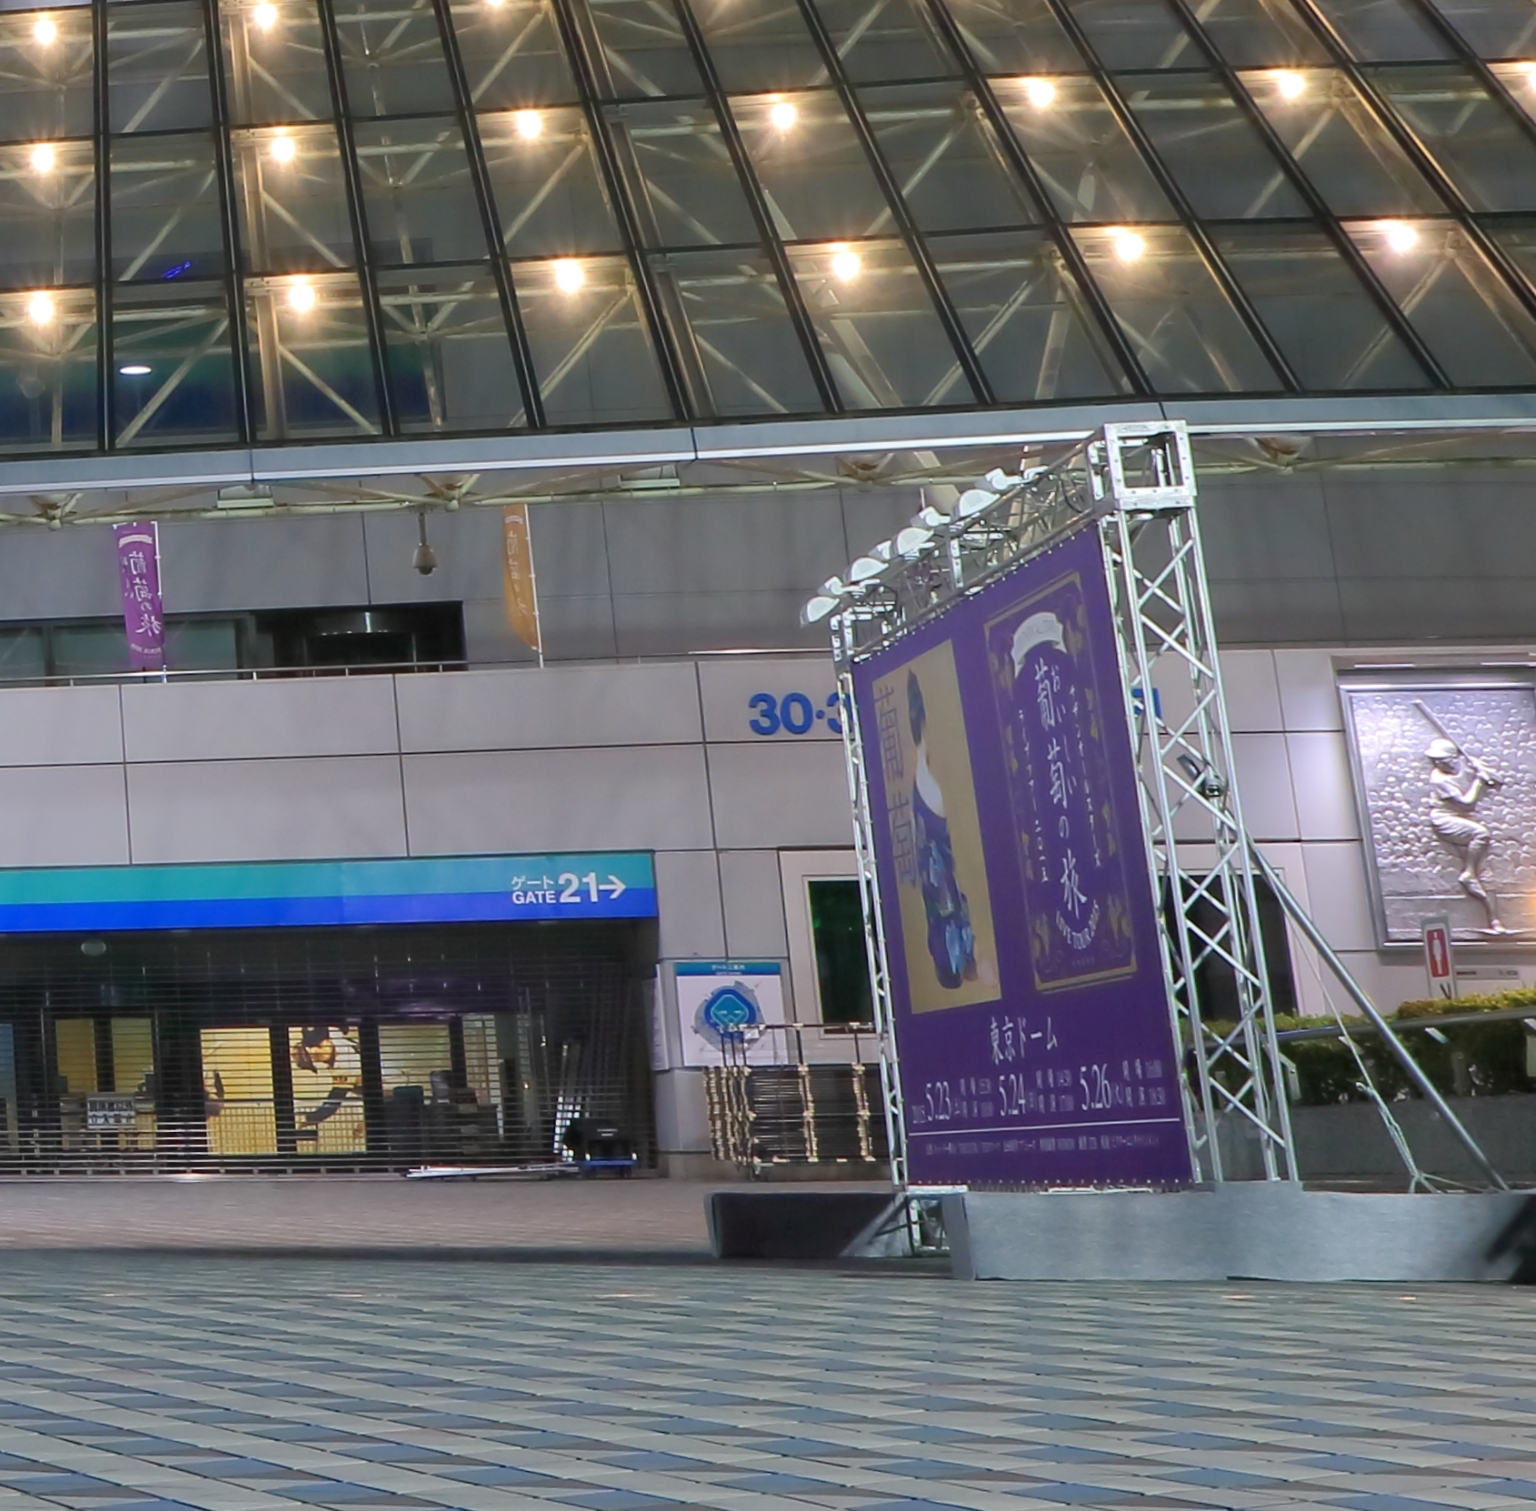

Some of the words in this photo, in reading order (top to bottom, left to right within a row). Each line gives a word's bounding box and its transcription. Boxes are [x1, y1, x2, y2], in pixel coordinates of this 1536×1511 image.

[1051, 665, 1077, 794] おいしい
[1035, 657, 1087, 919] 葡萄の旅
[511, 875, 554, 890] ゲート
[512, 891, 557, 904] GATE
[558, 872, 598, 903] 21
[990, 1015, 1058, 1065] 東京ドーム
